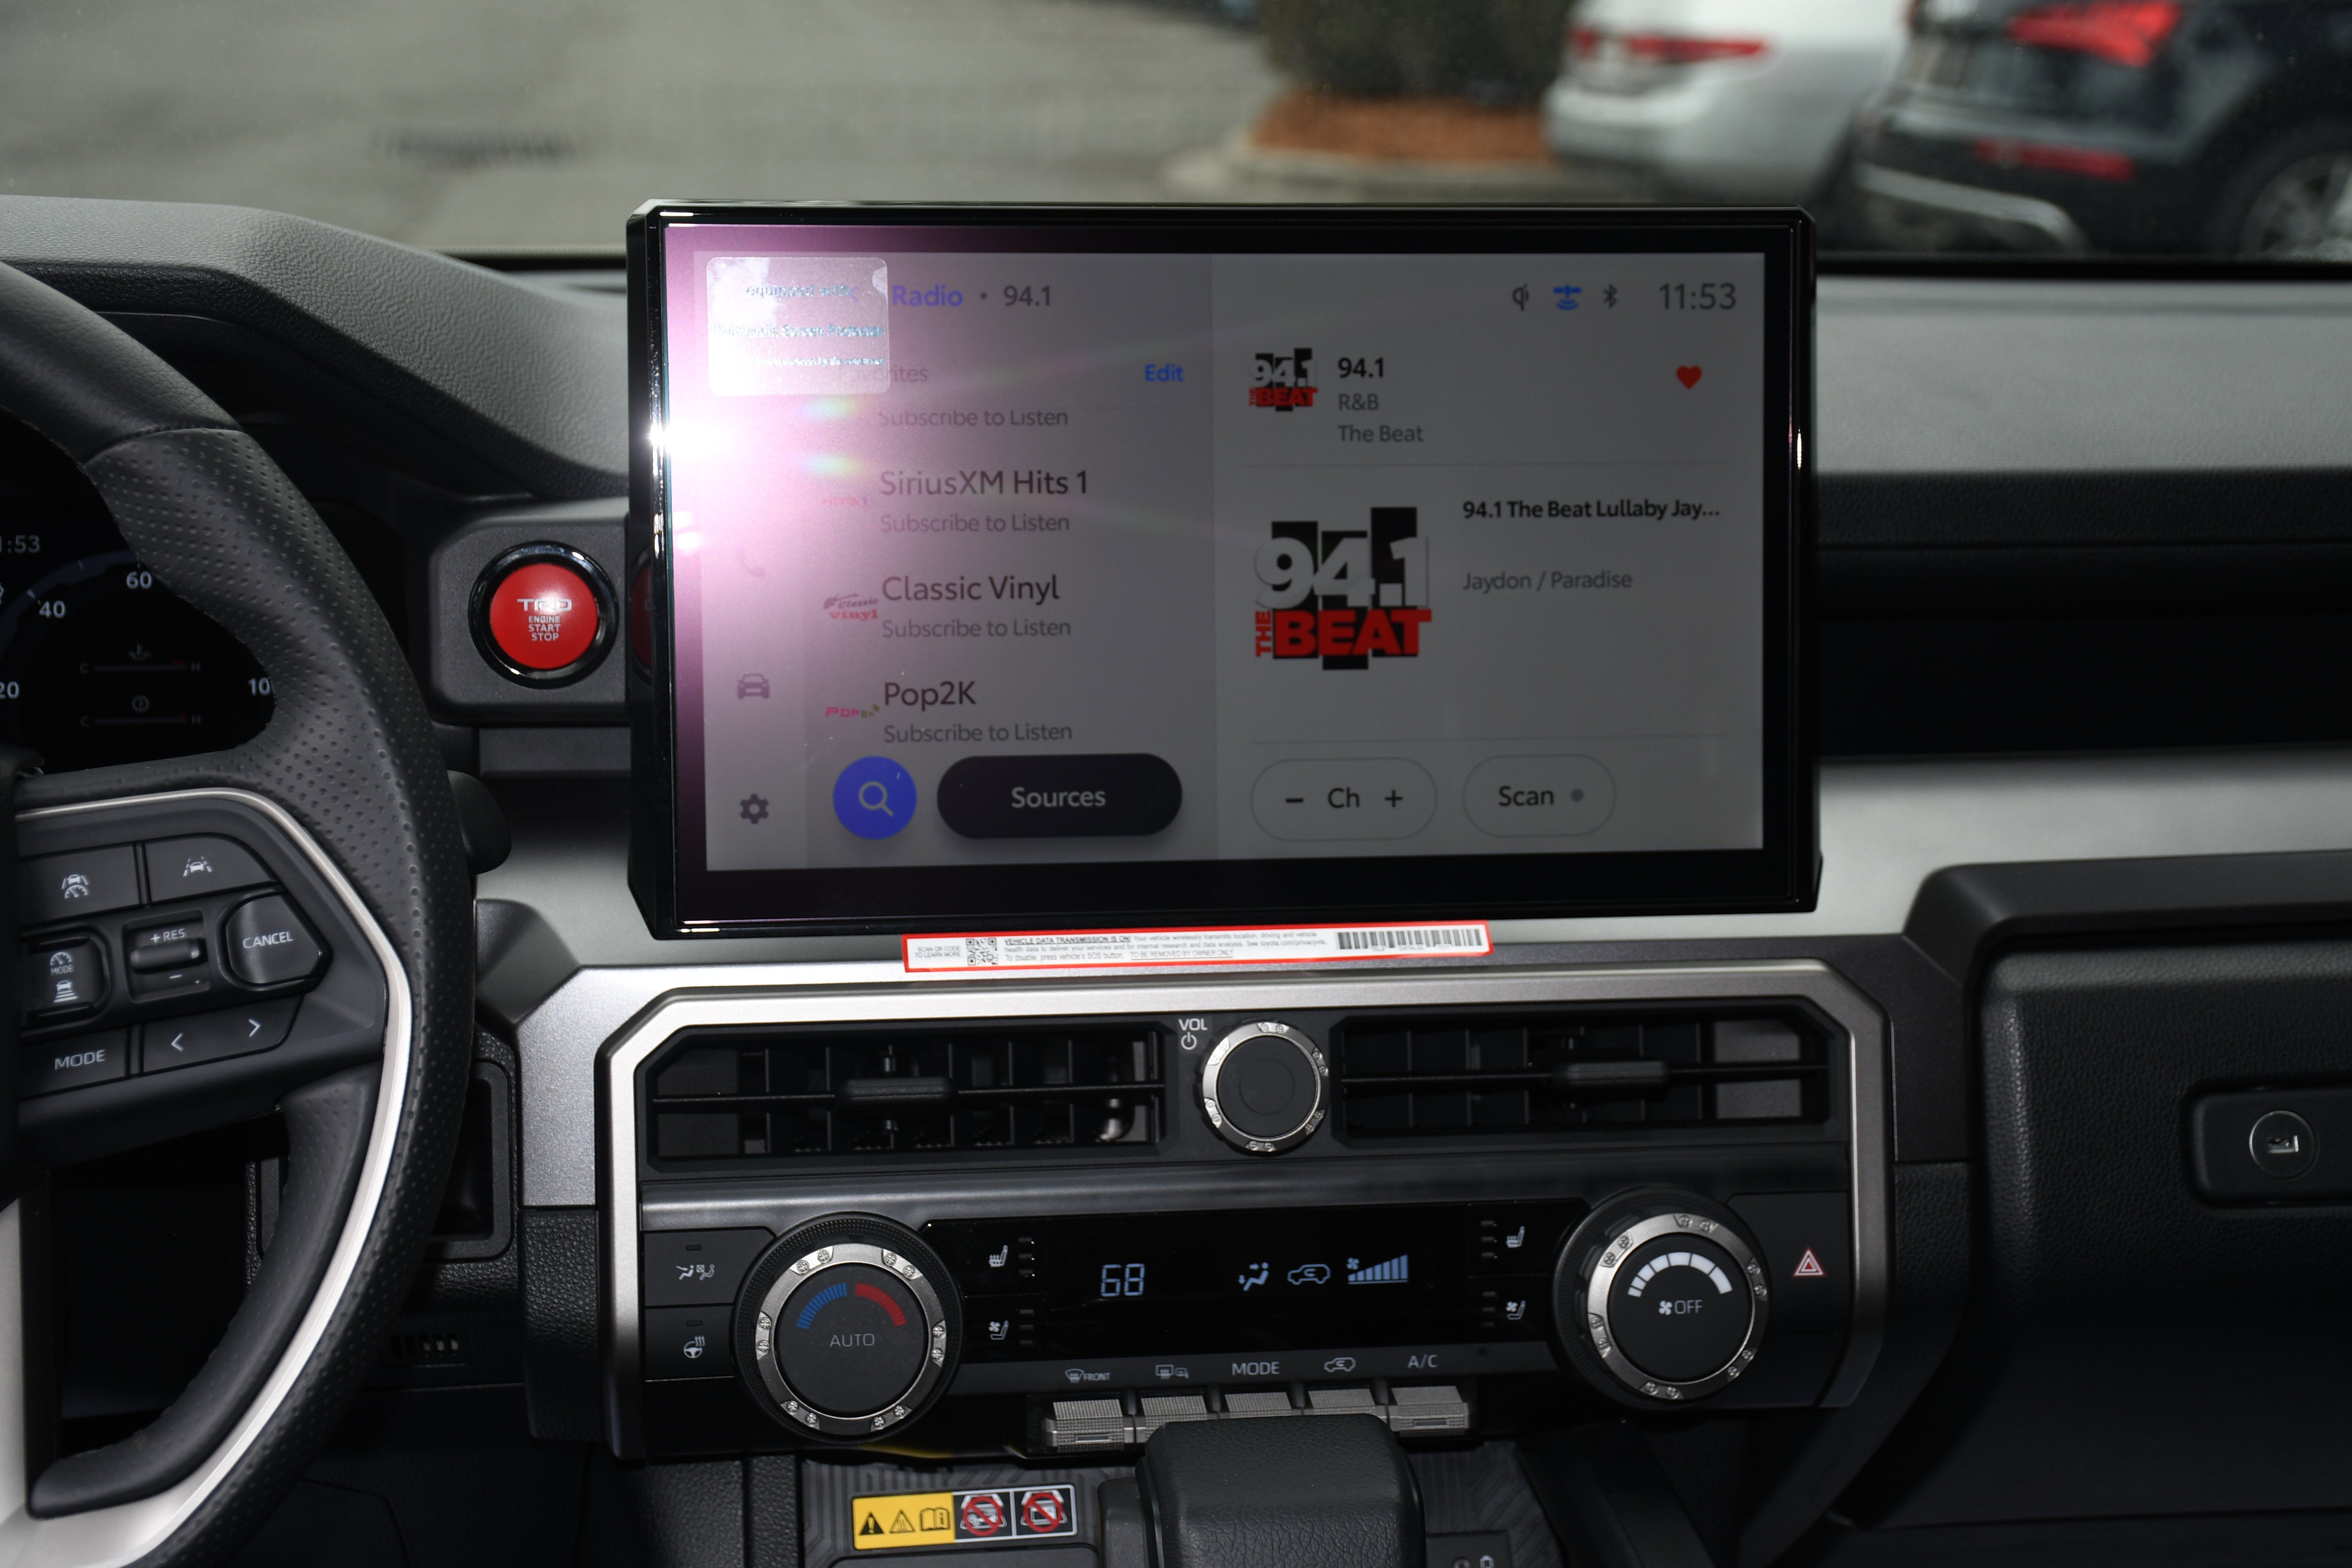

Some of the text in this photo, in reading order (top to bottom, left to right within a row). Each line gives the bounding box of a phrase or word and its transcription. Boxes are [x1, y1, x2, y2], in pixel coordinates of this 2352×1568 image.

[892, 285, 1051, 307] Radio 94.1
[1659, 283, 1737, 310] 11:53
[1145, 364, 1184, 382] Edit
[1250, 359, 1316, 388] 94.1
[1338, 358, 1384, 379] 94.1
[1257, 387, 1318, 406] BEAT
[1339, 394, 1379, 411] R&B
[879, 410, 1068, 426] Subscribe to Listen
[1338, 425, 1423, 442] The Beat
[880, 470, 1087, 495] SiriusXM Hits 1
[1463, 501, 1503, 518] 94.1
[1507, 501, 1543, 518] The
[1548, 501, 1592, 518] Beat
[1596, 500, 1667, 520] Lullaby
[881, 514, 1070, 533] Subscribe to Listen
[126, 572, 152, 589] 60
[1255, 536, 1429, 610] 94.1
[1463, 572, 1531, 593] Jaydon
[1552, 571, 1632, 589] Paradise
[882, 574, 1060, 605] Classic Vinyl
[39, 600, 66, 618] 40
[517, 598, 572, 612] TRD
[528, 624, 561, 632] START
[531, 633, 559, 641] STOP
[882, 618, 1071, 638] Subscribe to Listen
[1255, 611, 1271, 657] THE
[1274, 609, 1432, 656] BEAT
[884, 681, 976, 711] Pop2K
[884, 722, 1072, 744] Subscribe to Listen
[1011, 787, 1106, 808] Sources
[1328, 787, 1360, 808] Ch
[1499, 785, 1554, 806] Scan
[242, 931, 293, 949] CANCEL
[51, 963, 74, 975] MODE
[1179, 1018, 1208, 1031] VOL
[54, 1049, 106, 1070] MODE
[1101, 1263, 1145, 1296] 68
[1674, 1299, 1703, 1315] OFF
[830, 1333, 875, 1347] AUTO
[1232, 1361, 1279, 1376] MODE
[1407, 1355, 1438, 1369] A/C
[1083, 1372, 1111, 1381] FRONT
